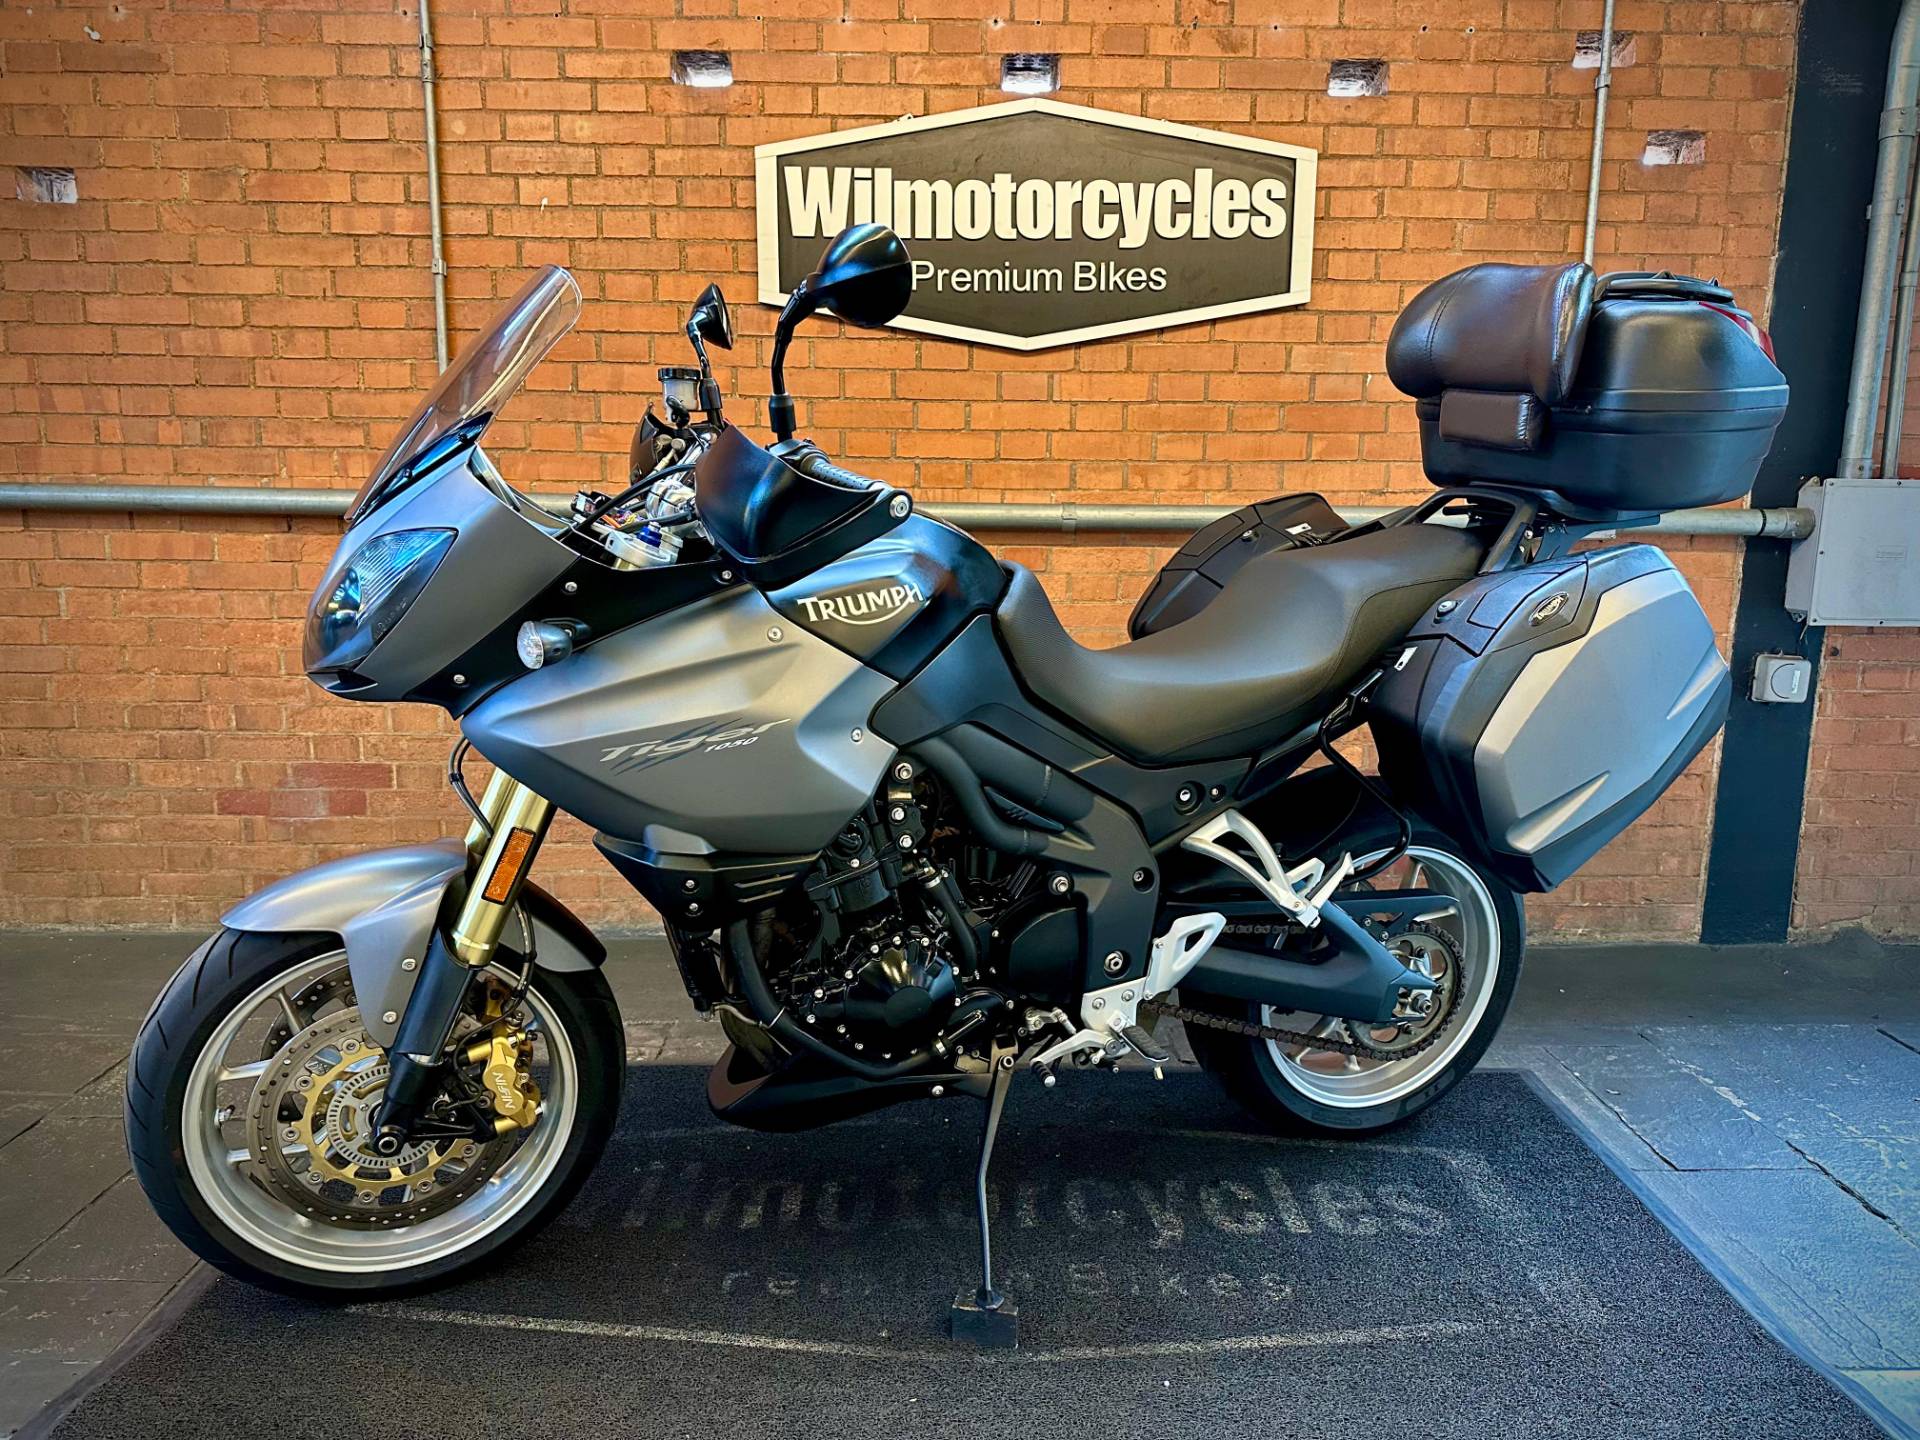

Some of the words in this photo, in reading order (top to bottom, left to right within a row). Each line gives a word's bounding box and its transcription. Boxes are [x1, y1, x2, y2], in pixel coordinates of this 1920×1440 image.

[783, 165, 1287, 249] Wilmotorcycles
[911, 260, 1063, 292] Premium
[797, 582, 924, 625] TRIUMPH
[600, 718, 792, 763] Tiger
[703, 736, 759, 753] 1050
